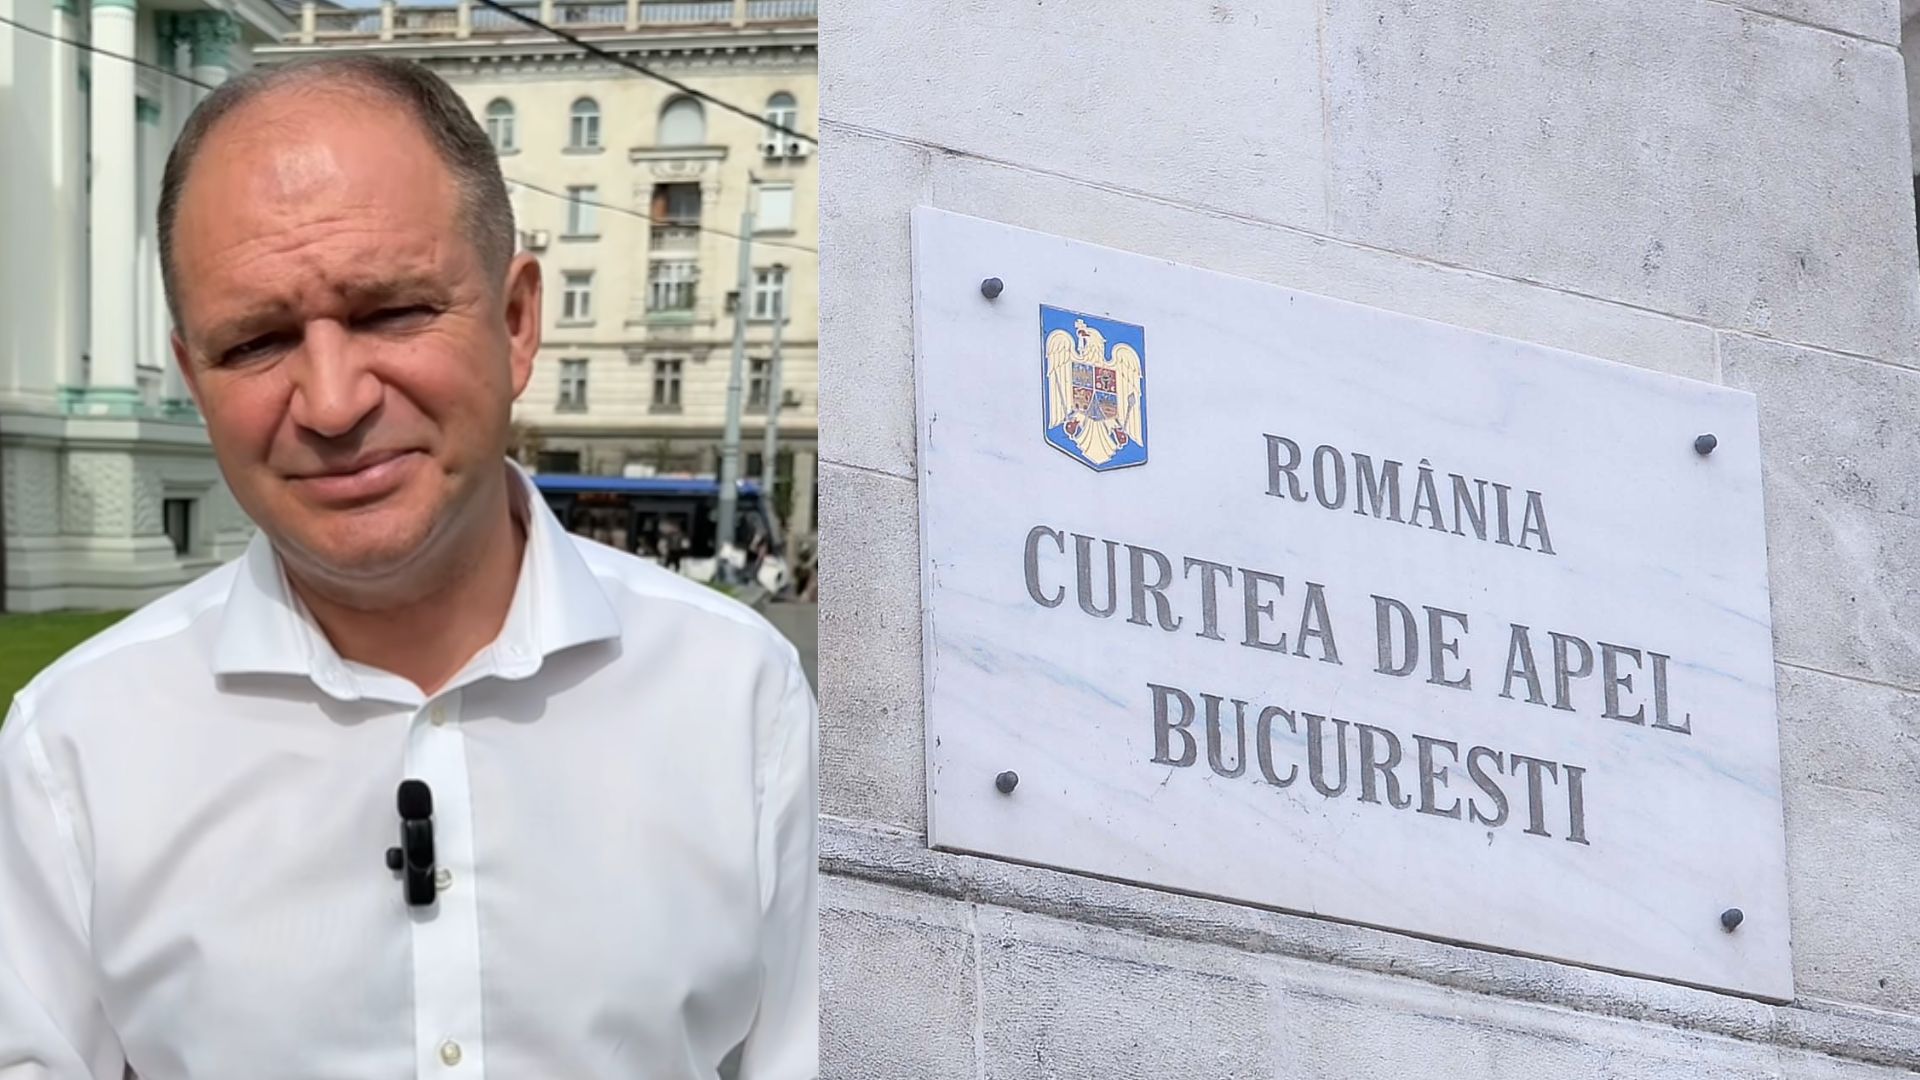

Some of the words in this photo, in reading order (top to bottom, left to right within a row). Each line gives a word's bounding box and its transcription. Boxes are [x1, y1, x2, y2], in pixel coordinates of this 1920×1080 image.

[1263, 433, 1556, 555] ROMÂNIA
[1024, 525, 1342, 665] CURTEA
[1370, 594, 1472, 690] DE
[1499, 623, 1691, 735] APEL
[1147, 683, 1590, 845] BUCUREȘTI
